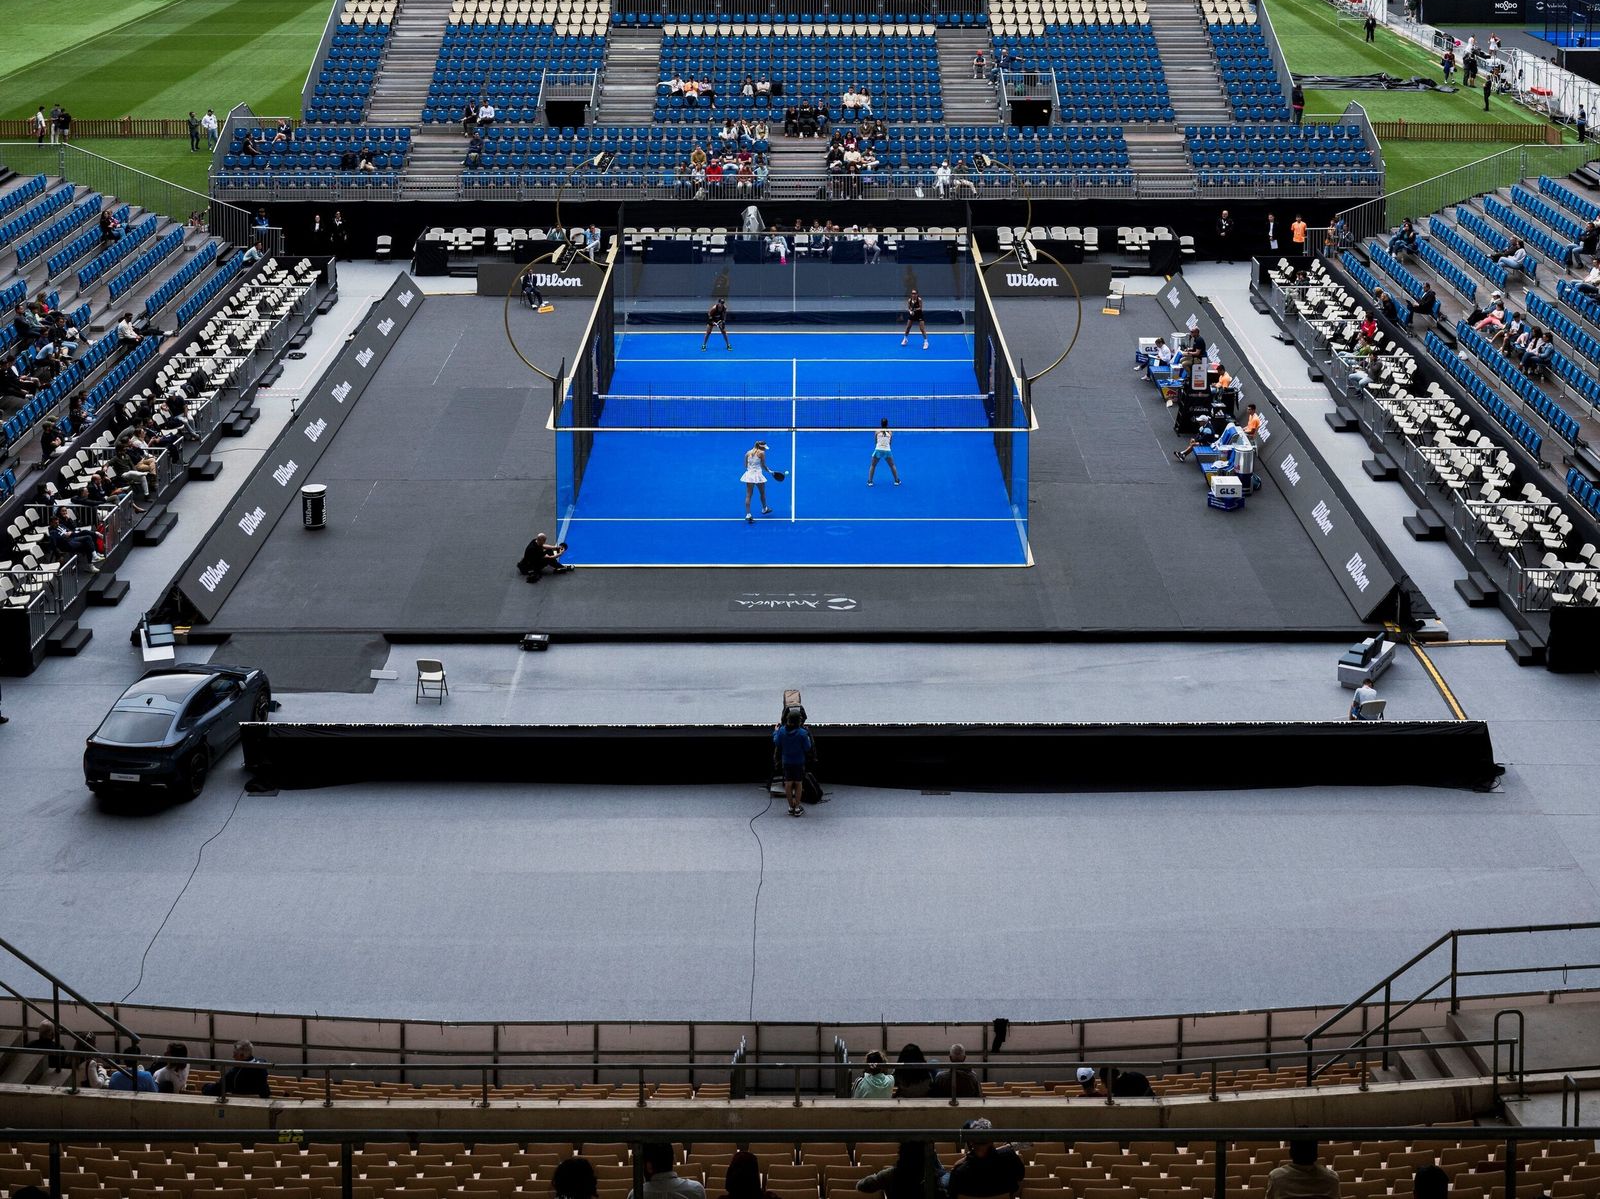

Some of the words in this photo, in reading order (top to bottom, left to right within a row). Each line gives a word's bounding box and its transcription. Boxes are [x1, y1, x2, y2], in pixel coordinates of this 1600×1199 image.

[533, 273, 583, 287] Wilson
[1006, 273, 1060, 287] Wilson
[397, 289, 415, 308] Wilson
[377, 317, 396, 337] Wilson
[355, 347, 375, 369] Wilson
[331, 380, 353, 404] Wilson
[303, 417, 328, 443] Wilson
[272, 459, 299, 487] Wilson
[1280, 453, 1301, 487] Wilson
[238, 506, 267, 536] Wilson
[1311, 500, 1334, 537] Wilson
[199, 558, 231, 593] Wilson
[1345, 552, 1370, 593] Wilson
